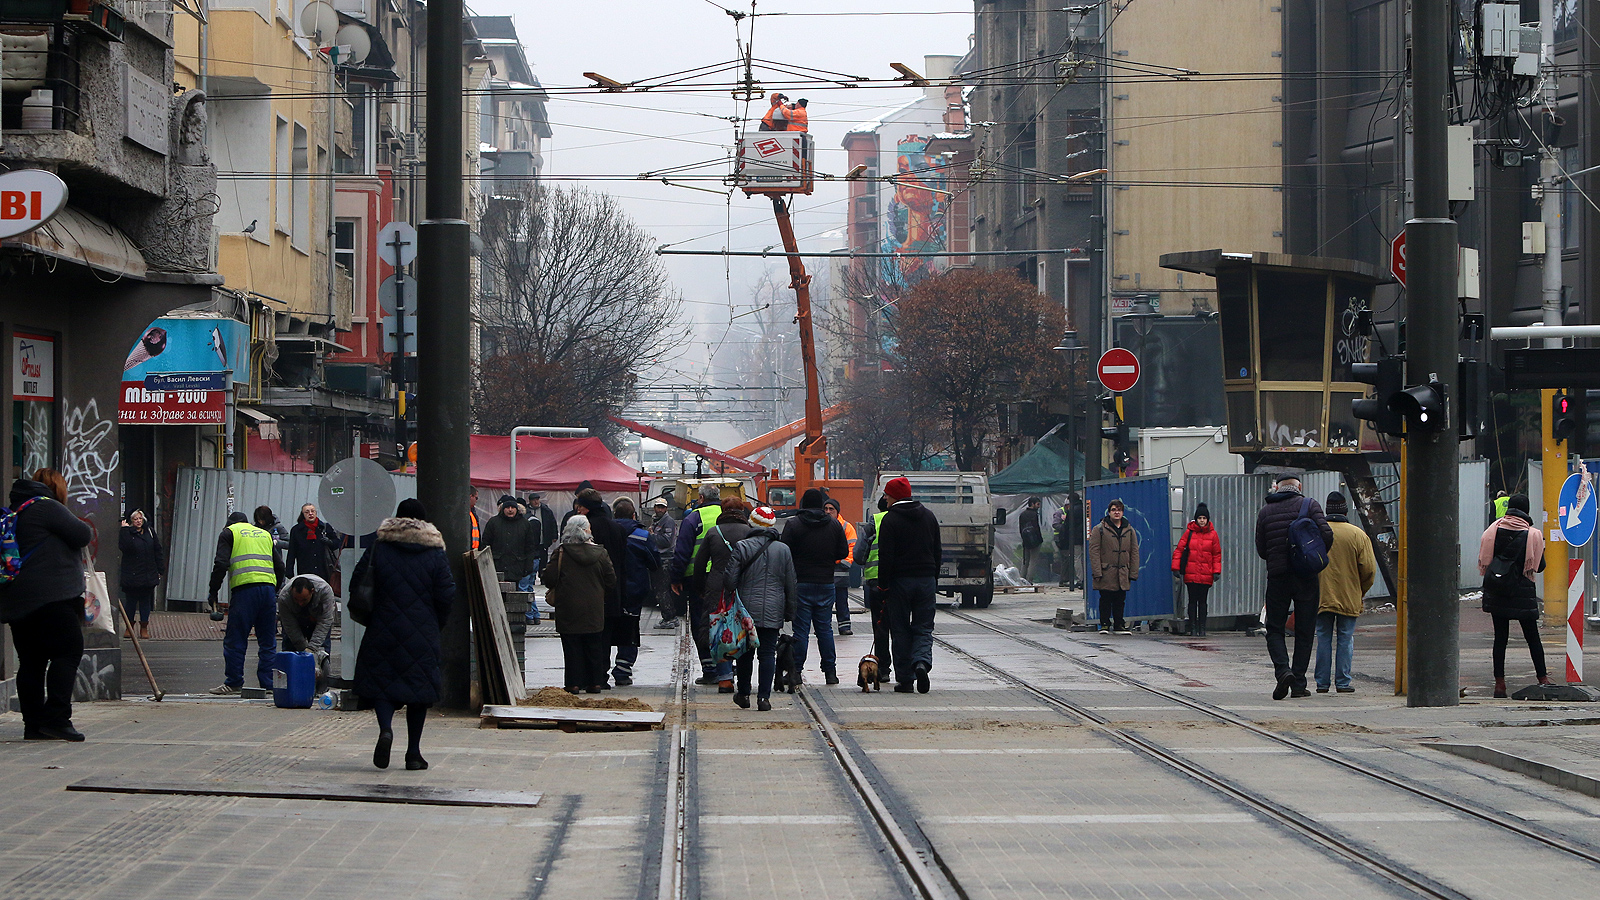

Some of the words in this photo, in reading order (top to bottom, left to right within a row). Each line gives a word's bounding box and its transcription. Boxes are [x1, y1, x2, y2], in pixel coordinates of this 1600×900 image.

[177, 389, 207, 404] 2000
[118, 409, 136, 420] ни
[140, 409, 150, 420] и
[150, 405, 185, 424] здраве
[186, 410, 197, 420] за
[198, 410, 222, 422] всички
